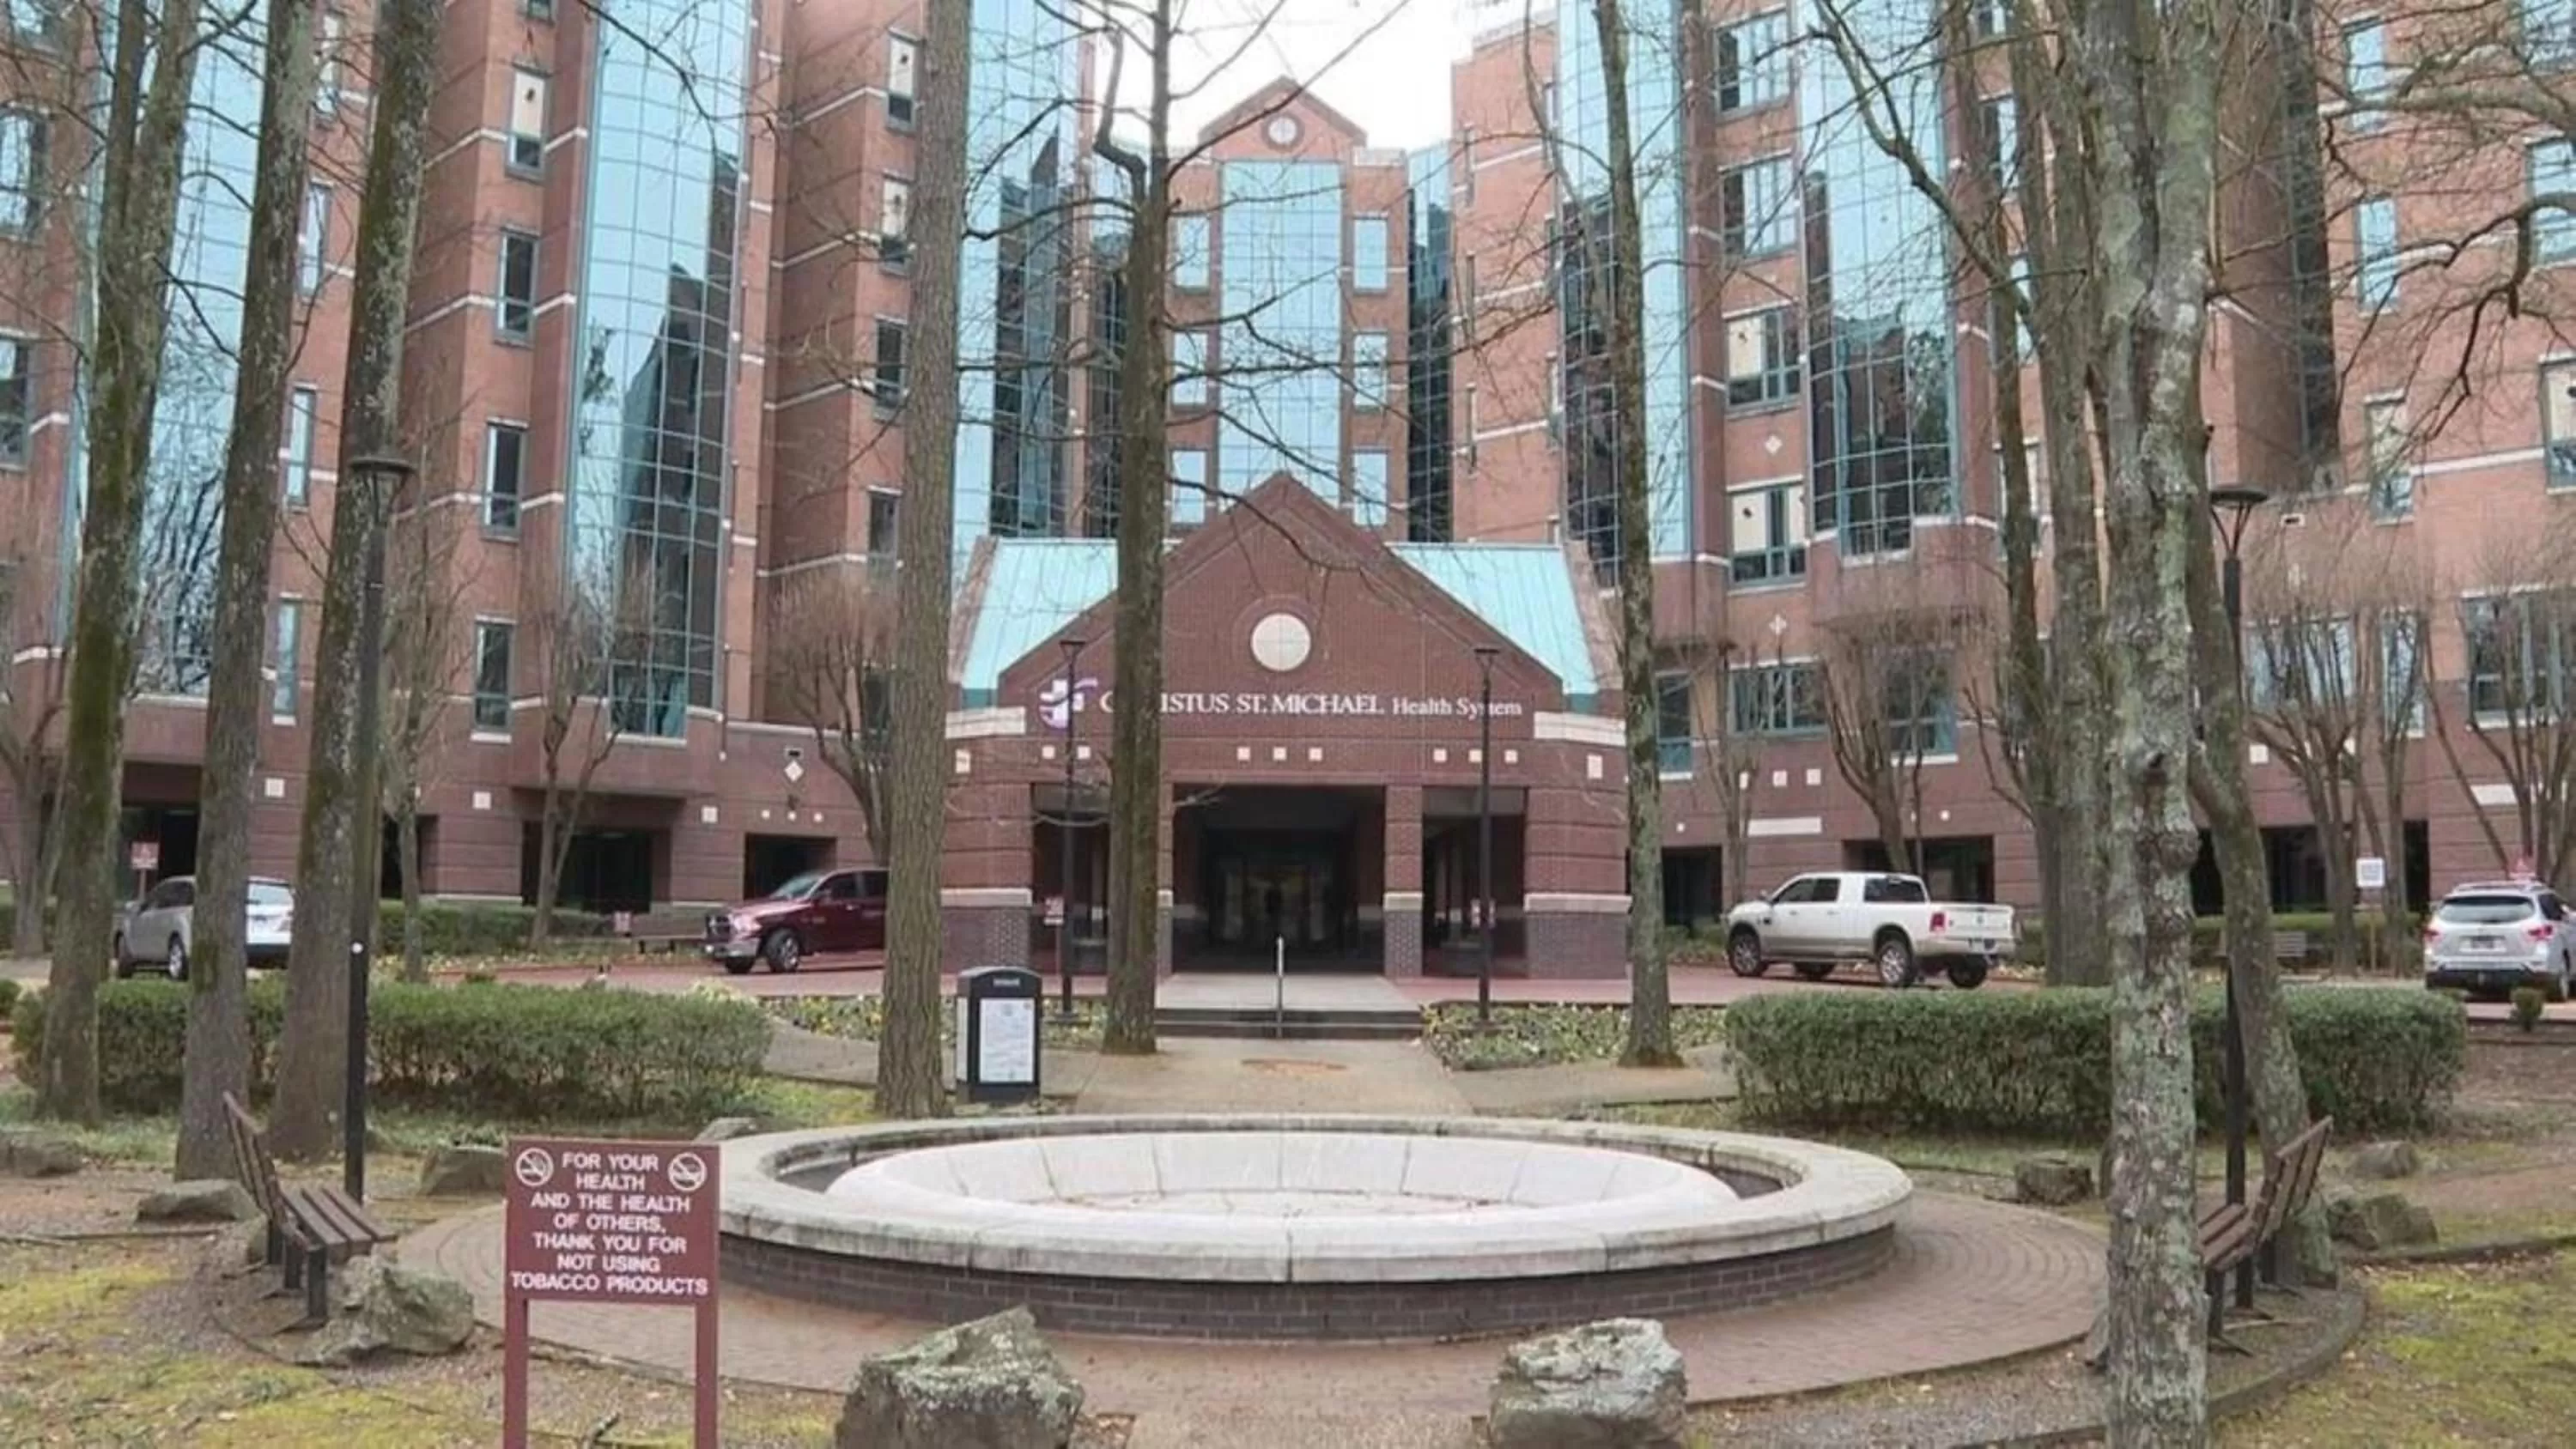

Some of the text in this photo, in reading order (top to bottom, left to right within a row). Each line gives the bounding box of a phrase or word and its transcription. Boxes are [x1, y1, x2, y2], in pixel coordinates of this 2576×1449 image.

[1099, 690, 1230, 713] CISTUS
[1392, 697, 1452, 715] Health
[1456, 698, 1522, 719] Sytem
[562, 1152, 659, 1171] FOR YOUR
[575, 1173, 646, 1191] HEALTH
[531, 1192, 690, 1213] AND THE HEALTH
[553, 1213, 580, 1229] OF
[532, 1233, 687, 1254] THANK YOU FOR
[557, 1254, 661, 1273] NOT USING
[510, 1271, 709, 1295] TOBACCO PRODUCTS
